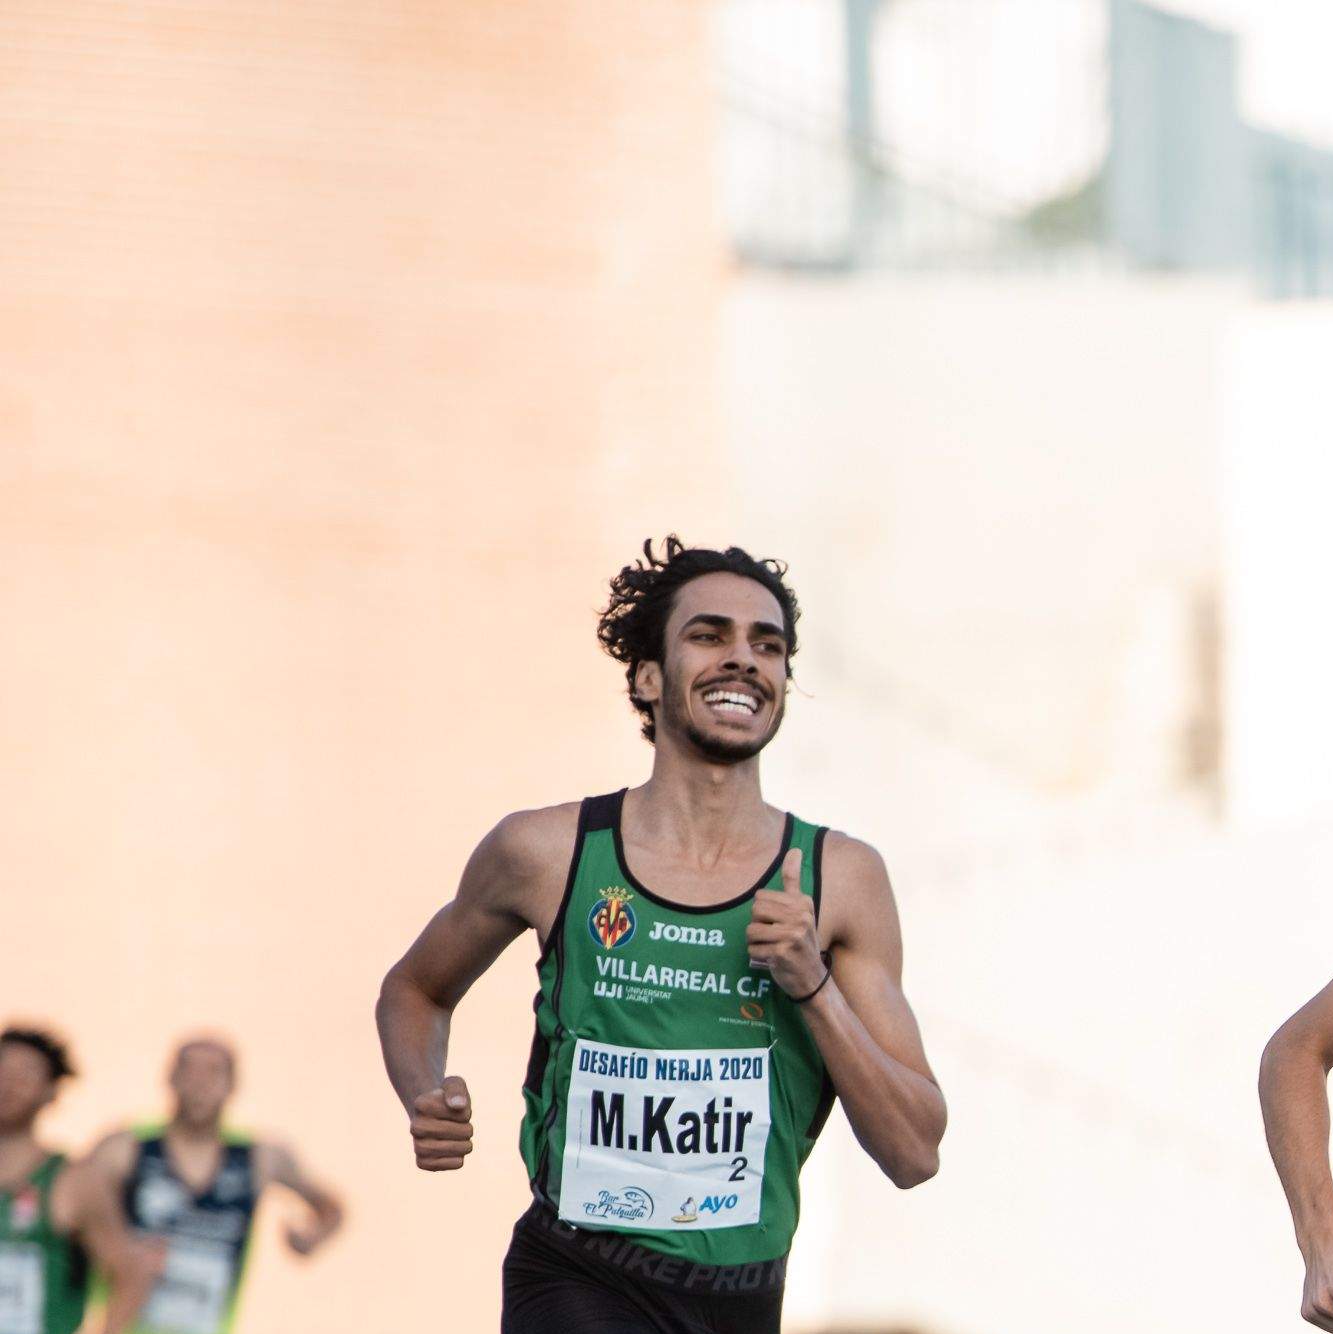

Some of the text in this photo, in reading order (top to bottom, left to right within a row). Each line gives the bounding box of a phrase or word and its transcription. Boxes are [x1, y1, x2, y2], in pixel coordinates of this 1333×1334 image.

[594, 980, 623, 999] UJI
[596, 955, 731, 995] VILLARREAL
[579, 1048, 763, 1081] DESAFÍO NERJA 2020
[590, 1089, 754, 1155] M.Katir
[728, 1156, 748, 1182] 2
